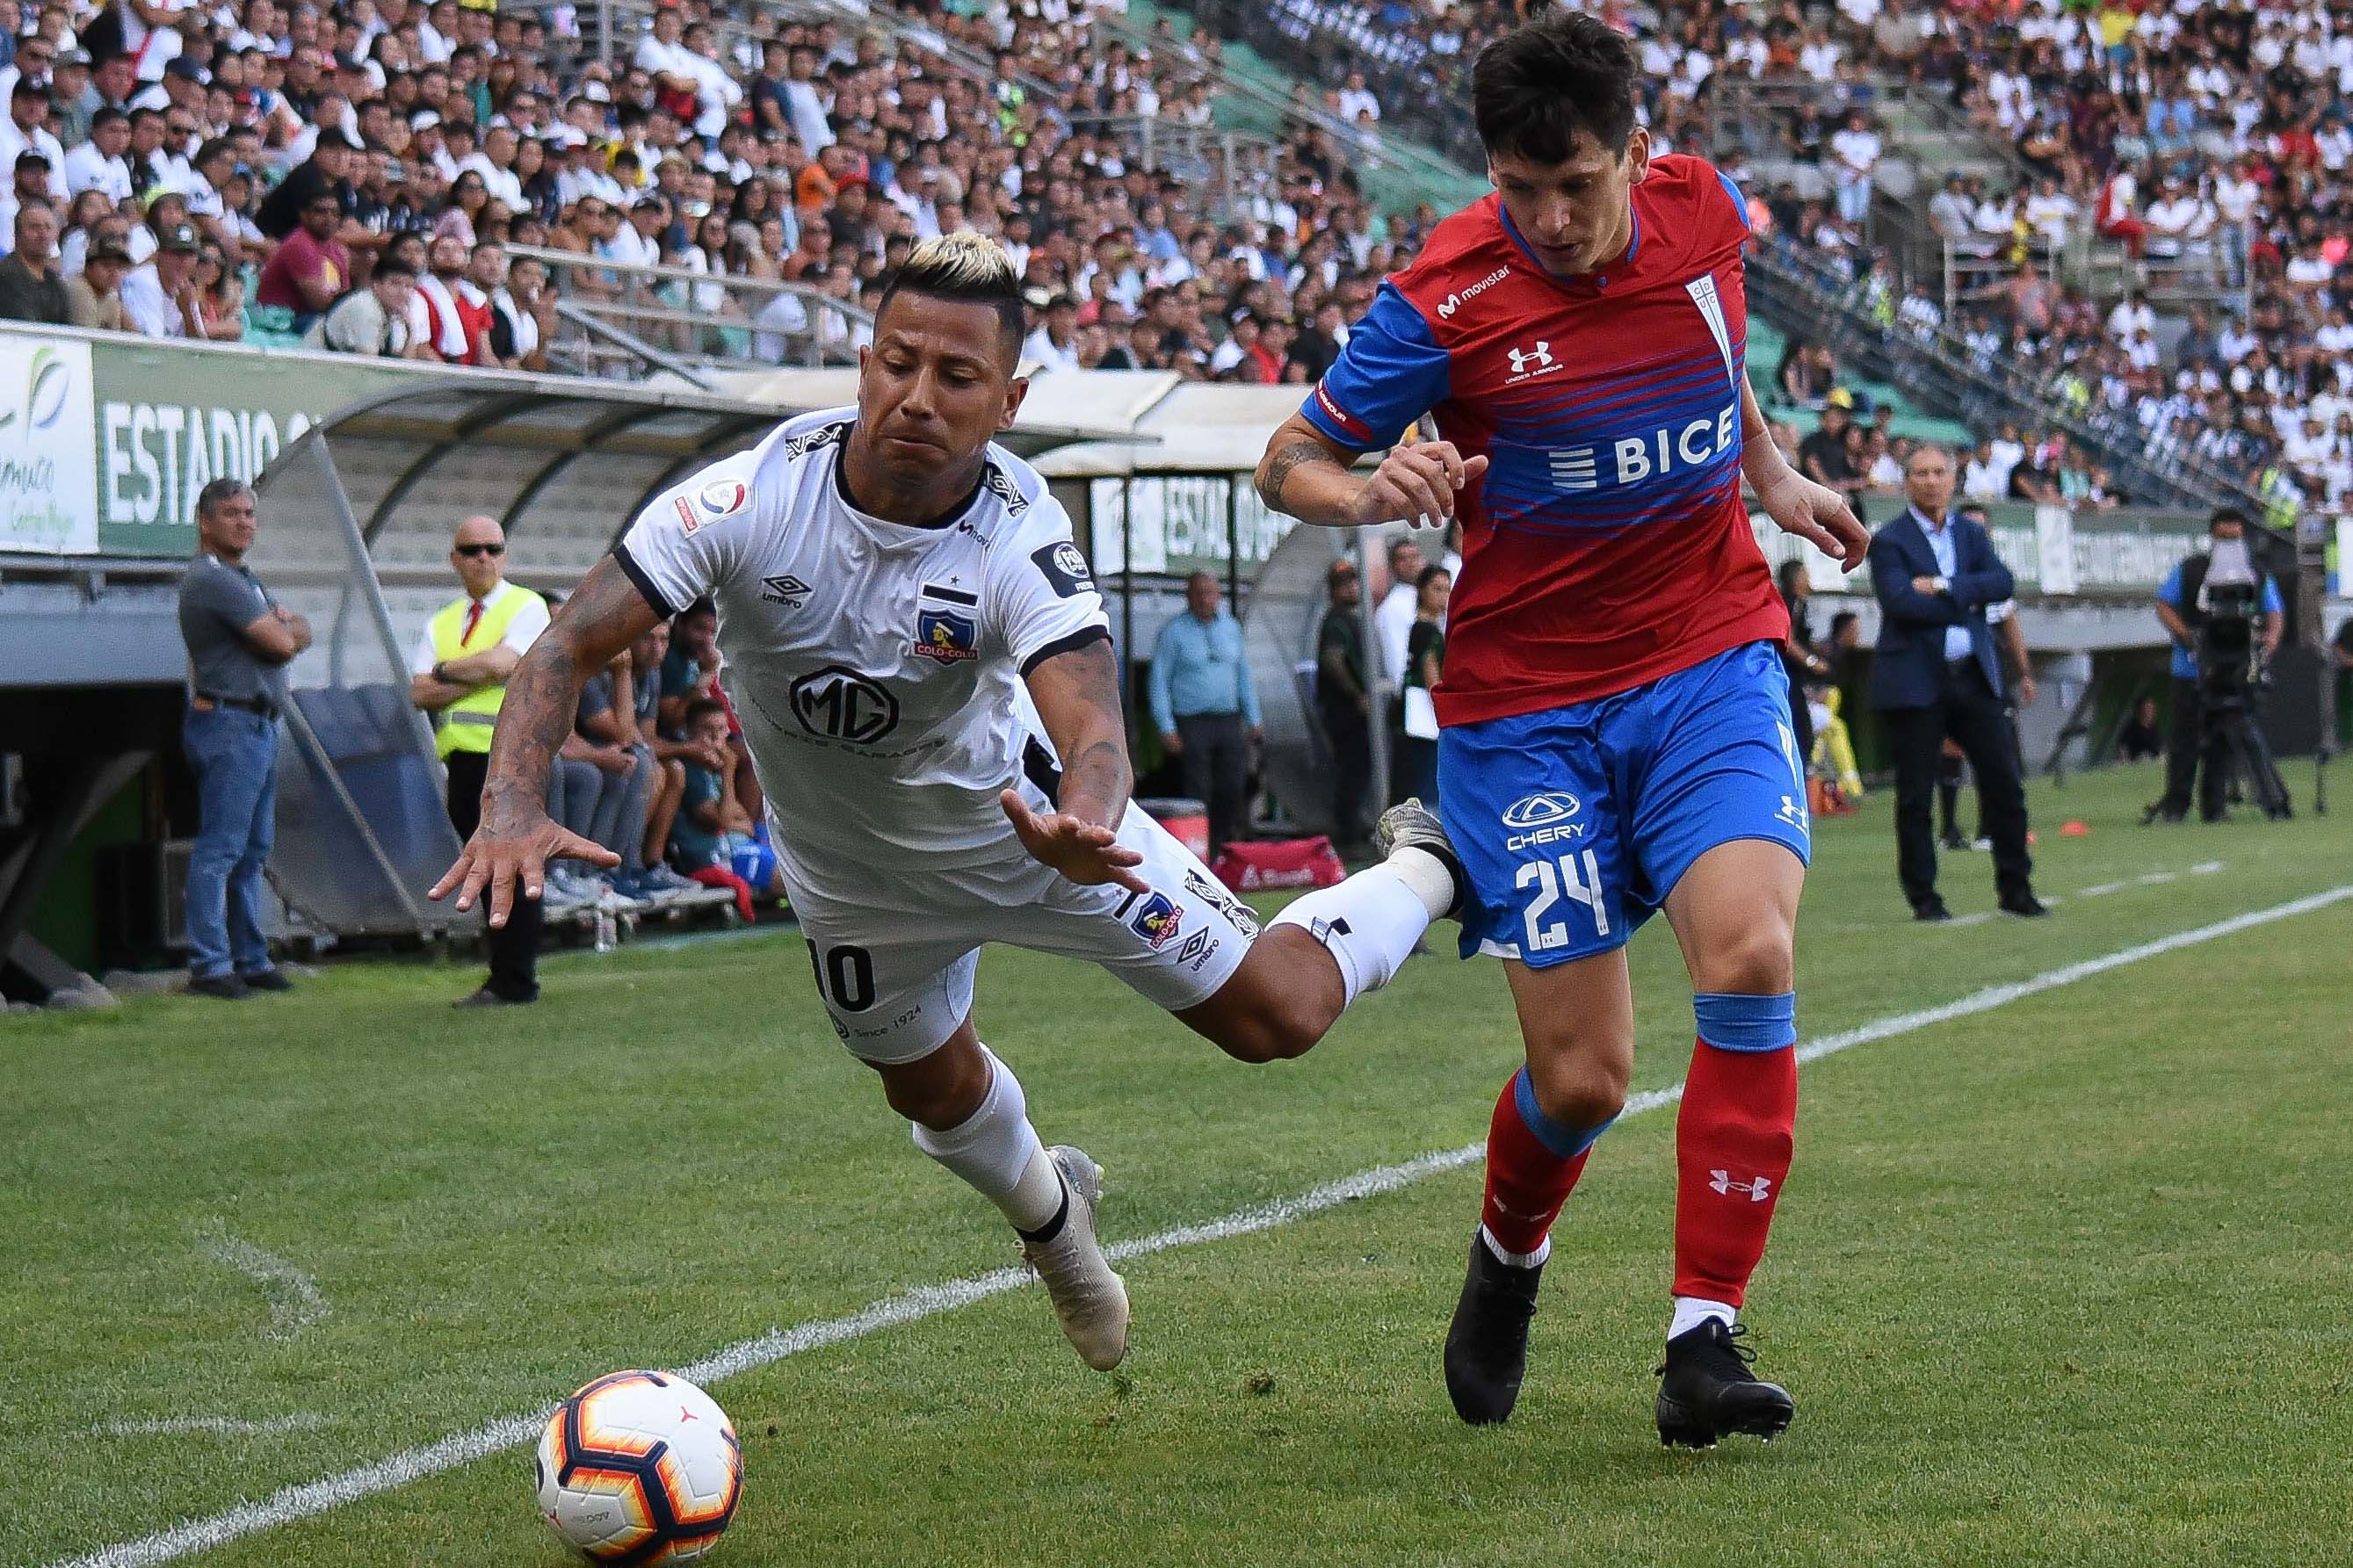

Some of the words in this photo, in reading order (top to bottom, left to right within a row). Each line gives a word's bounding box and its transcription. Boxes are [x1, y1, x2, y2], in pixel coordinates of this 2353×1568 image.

[1461, 264, 1510, 301] movistar
[1615, 402, 1734, 486] BICE
[762, 592, 802, 610] umbro
[917, 645, 976, 659] COLO-COLO
[800, 676, 888, 737] MG
[1507, 823, 1585, 851] CHERY
[1516, 849, 1610, 951] 24
[1152, 908, 1183, 948] COLO-COLO
[1191, 938, 1220, 972] umbro
[893, 1003, 923, 1030] 1924
